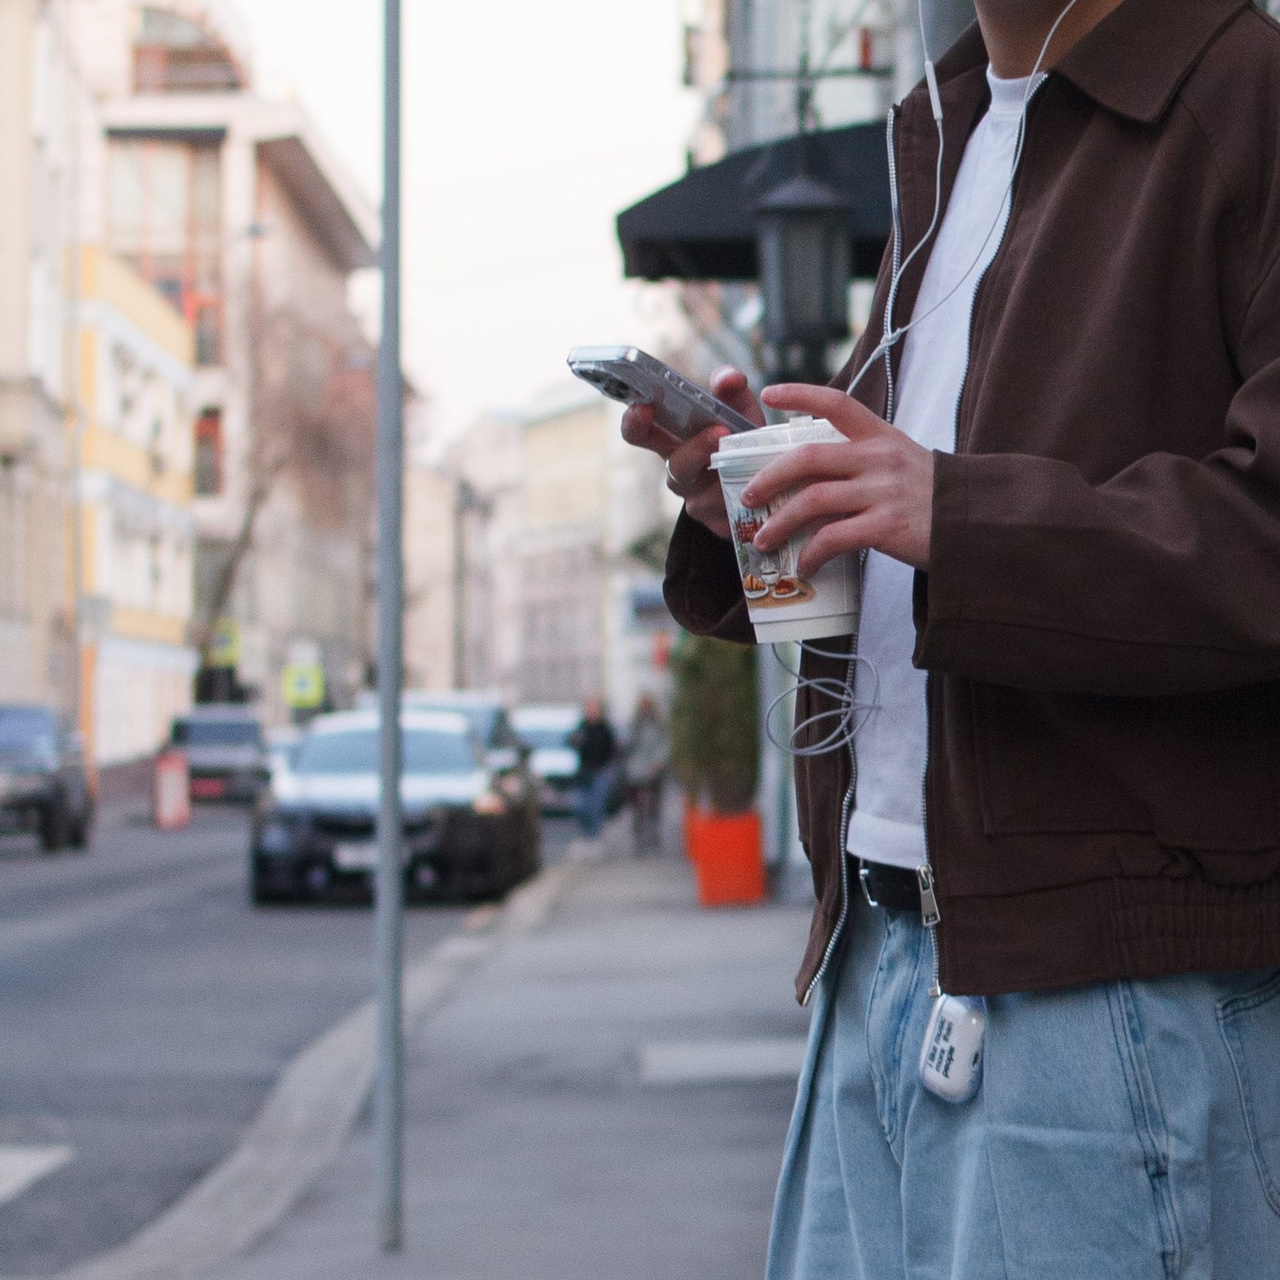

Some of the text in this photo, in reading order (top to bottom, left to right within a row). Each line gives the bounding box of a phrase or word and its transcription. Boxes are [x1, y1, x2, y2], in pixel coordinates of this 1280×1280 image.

[929, 1045, 937, 1062] like
[935, 1048, 945, 1072] more
[942, 1045, 955, 1078] people
